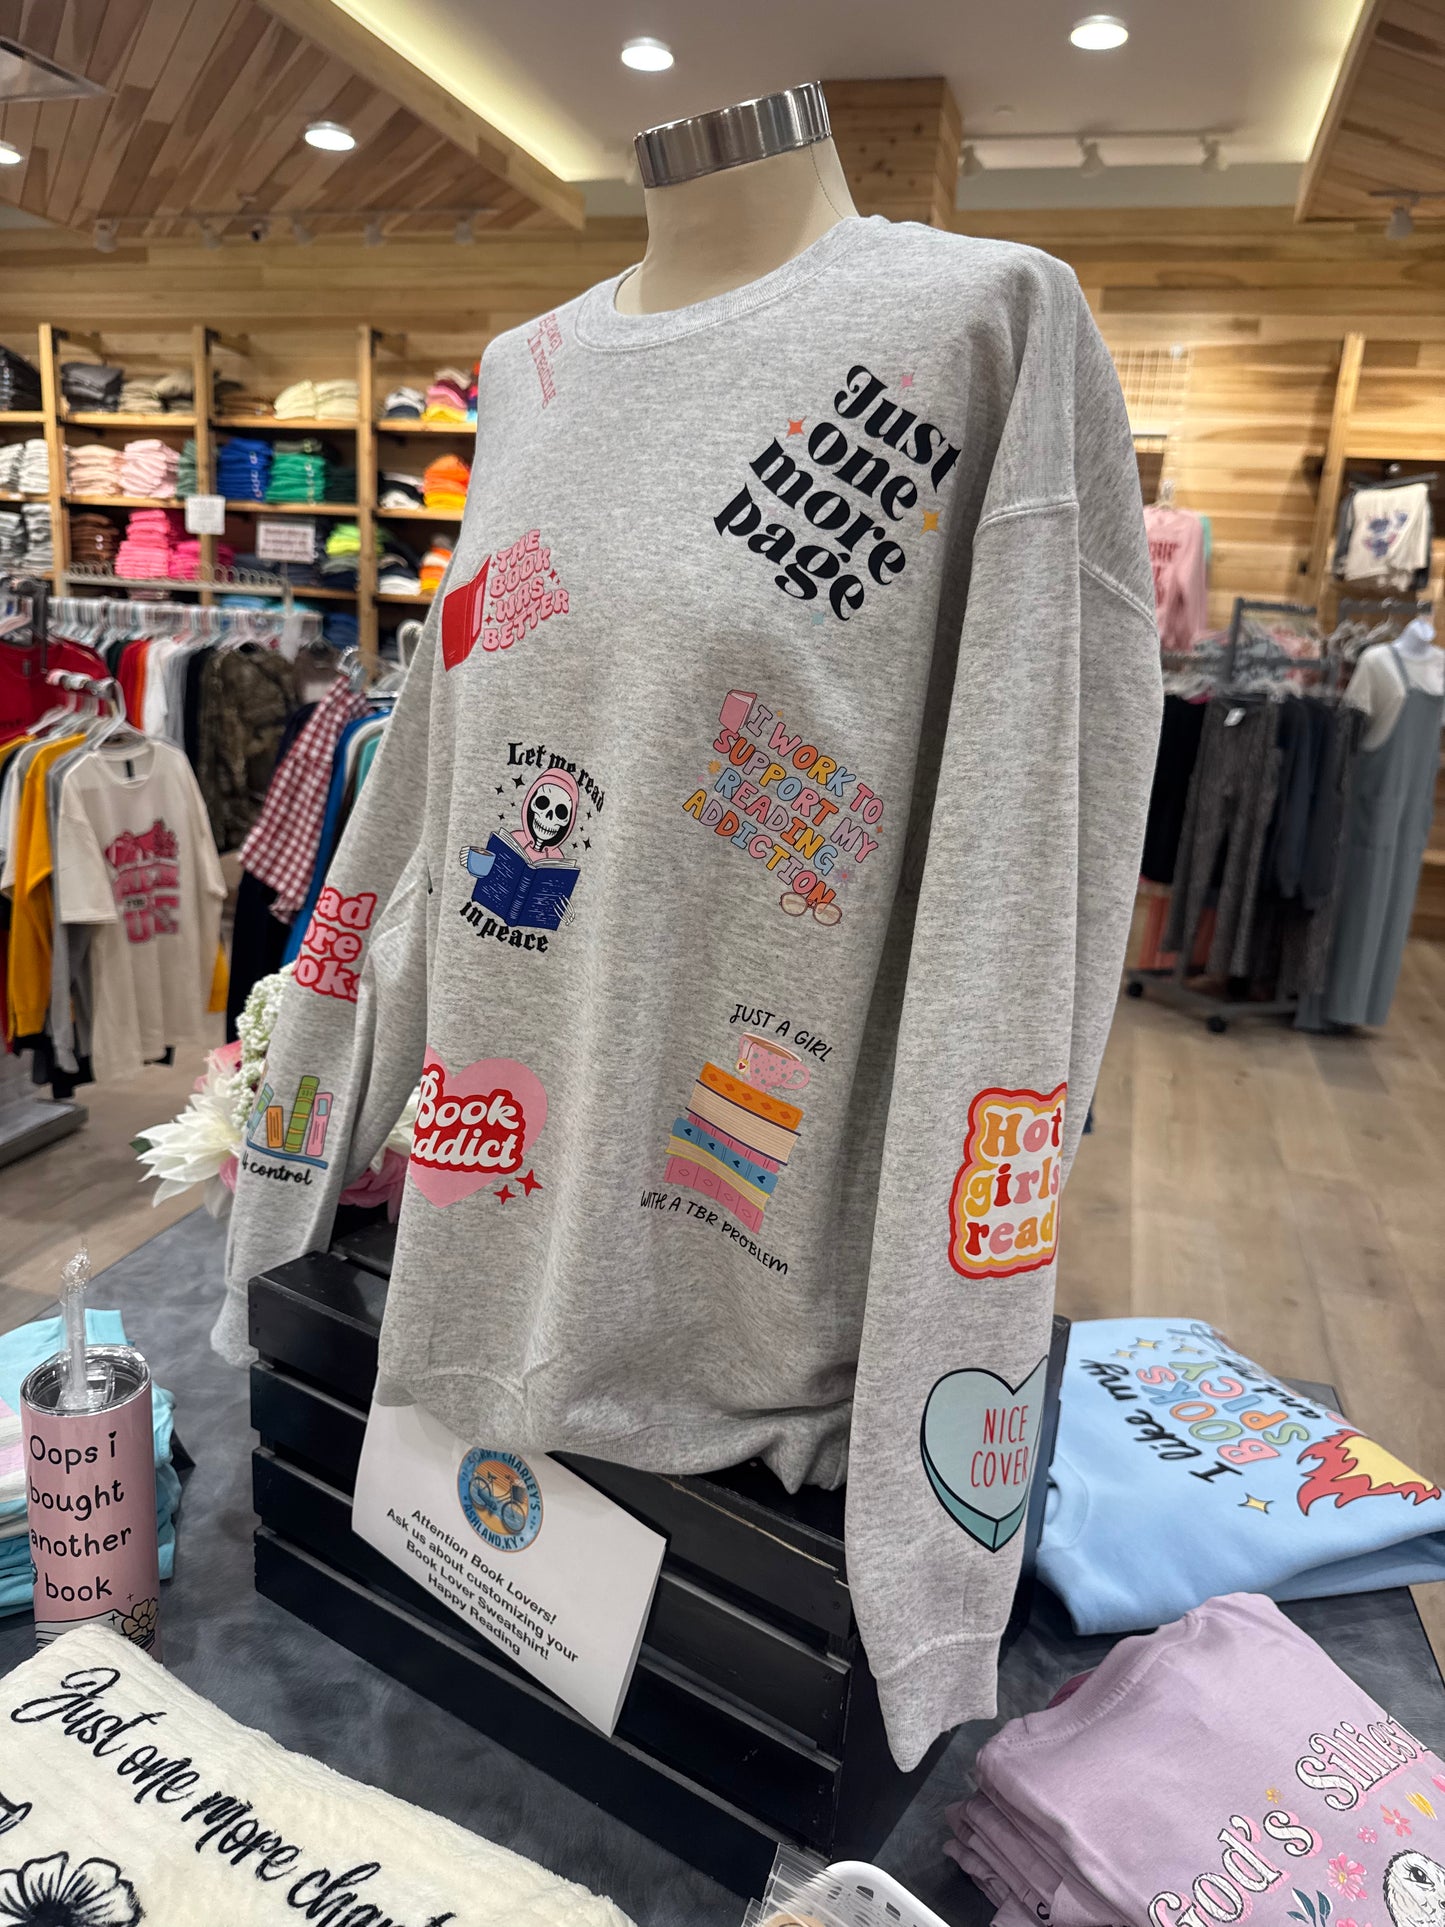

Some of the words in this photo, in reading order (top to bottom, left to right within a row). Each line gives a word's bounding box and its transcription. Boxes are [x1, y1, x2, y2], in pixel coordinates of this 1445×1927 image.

[834, 365, 962, 493] Just
[808, 422, 918, 522] one
[749, 437, 906, 586] more
[490, 547, 550, 598] BOOK
[497, 529, 540, 573] THE
[713, 482, 865, 621] page
[482, 588, 569, 652] BETTER
[496, 576, 544, 622] WAS
[507, 742, 546, 767] Let
[547, 752, 576, 774] me
[577, 768, 605, 813] read
[746, 704, 773, 737] I
[768, 722, 856, 797] WORK
[850, 783, 884, 824] TO
[713, 728, 839, 826] SUPPORT
[830, 817, 879, 863] MY
[714, 767, 838, 876] READING
[682, 788, 836, 914] ADDICTION
[318, 887, 377, 930] ad
[476, 917, 550, 953] peace
[729, 1003, 775, 1028] JUST
[775, 1020, 791, 1037] A
[794, 1030, 833, 1063] GIRL
[416, 1070, 519, 1130] Book
[411, 1128, 518, 1168] ddict
[981, 1107, 1062, 1157] Hot
[250, 1161, 313, 1185] control
[964, 1156, 1060, 1218] girls
[640, 1190, 666, 1210] WITH
[669, 1196, 682, 1211] A
[686, 1201, 721, 1226] TBR
[721, 1219, 788, 1275] PROBLEM
[964, 1200, 1056, 1256] read
[1080, 1359, 1138, 1401] my
[1168, 1360, 1310, 1445] SPICY
[983, 1405, 1029, 1444] NICE
[1124, 1408, 1204, 1460] like
[1135, 1364, 1281, 1465] BOOKS
[30, 1435, 98, 1474] Oops
[108, 1431, 117, 1458] i
[502, 1452, 541, 1512] CHARLEY'S
[970, 1446, 1029, 1488] COVER
[1188, 1461, 1243, 1483] I
[30, 1475, 124, 1521] bought
[30, 1527, 132, 1557] another
[411, 1509, 468, 1558] Attention
[470, 1554, 504, 1586] Book
[506, 1581, 557, 1625] Lovers!
[45, 1572, 112, 1602] book
[387, 1508, 409, 1531] Ask
[411, 1528, 426, 1544] us
[429, 1542, 464, 1574] about
[467, 1572, 544, 1639] customizing
[547, 1634, 579, 1662] your
[406, 1539, 437, 1571] Book
[440, 1566, 475, 1599] Lover
[478, 1596, 550, 1660] Sweatshirt!
[428, 1573, 467, 1610] Happy
[470, 1606, 520, 1656] Reading
[10, 1667, 166, 1757] Just
[117, 1744, 200, 1804] one
[181, 1790, 303, 1881] more
